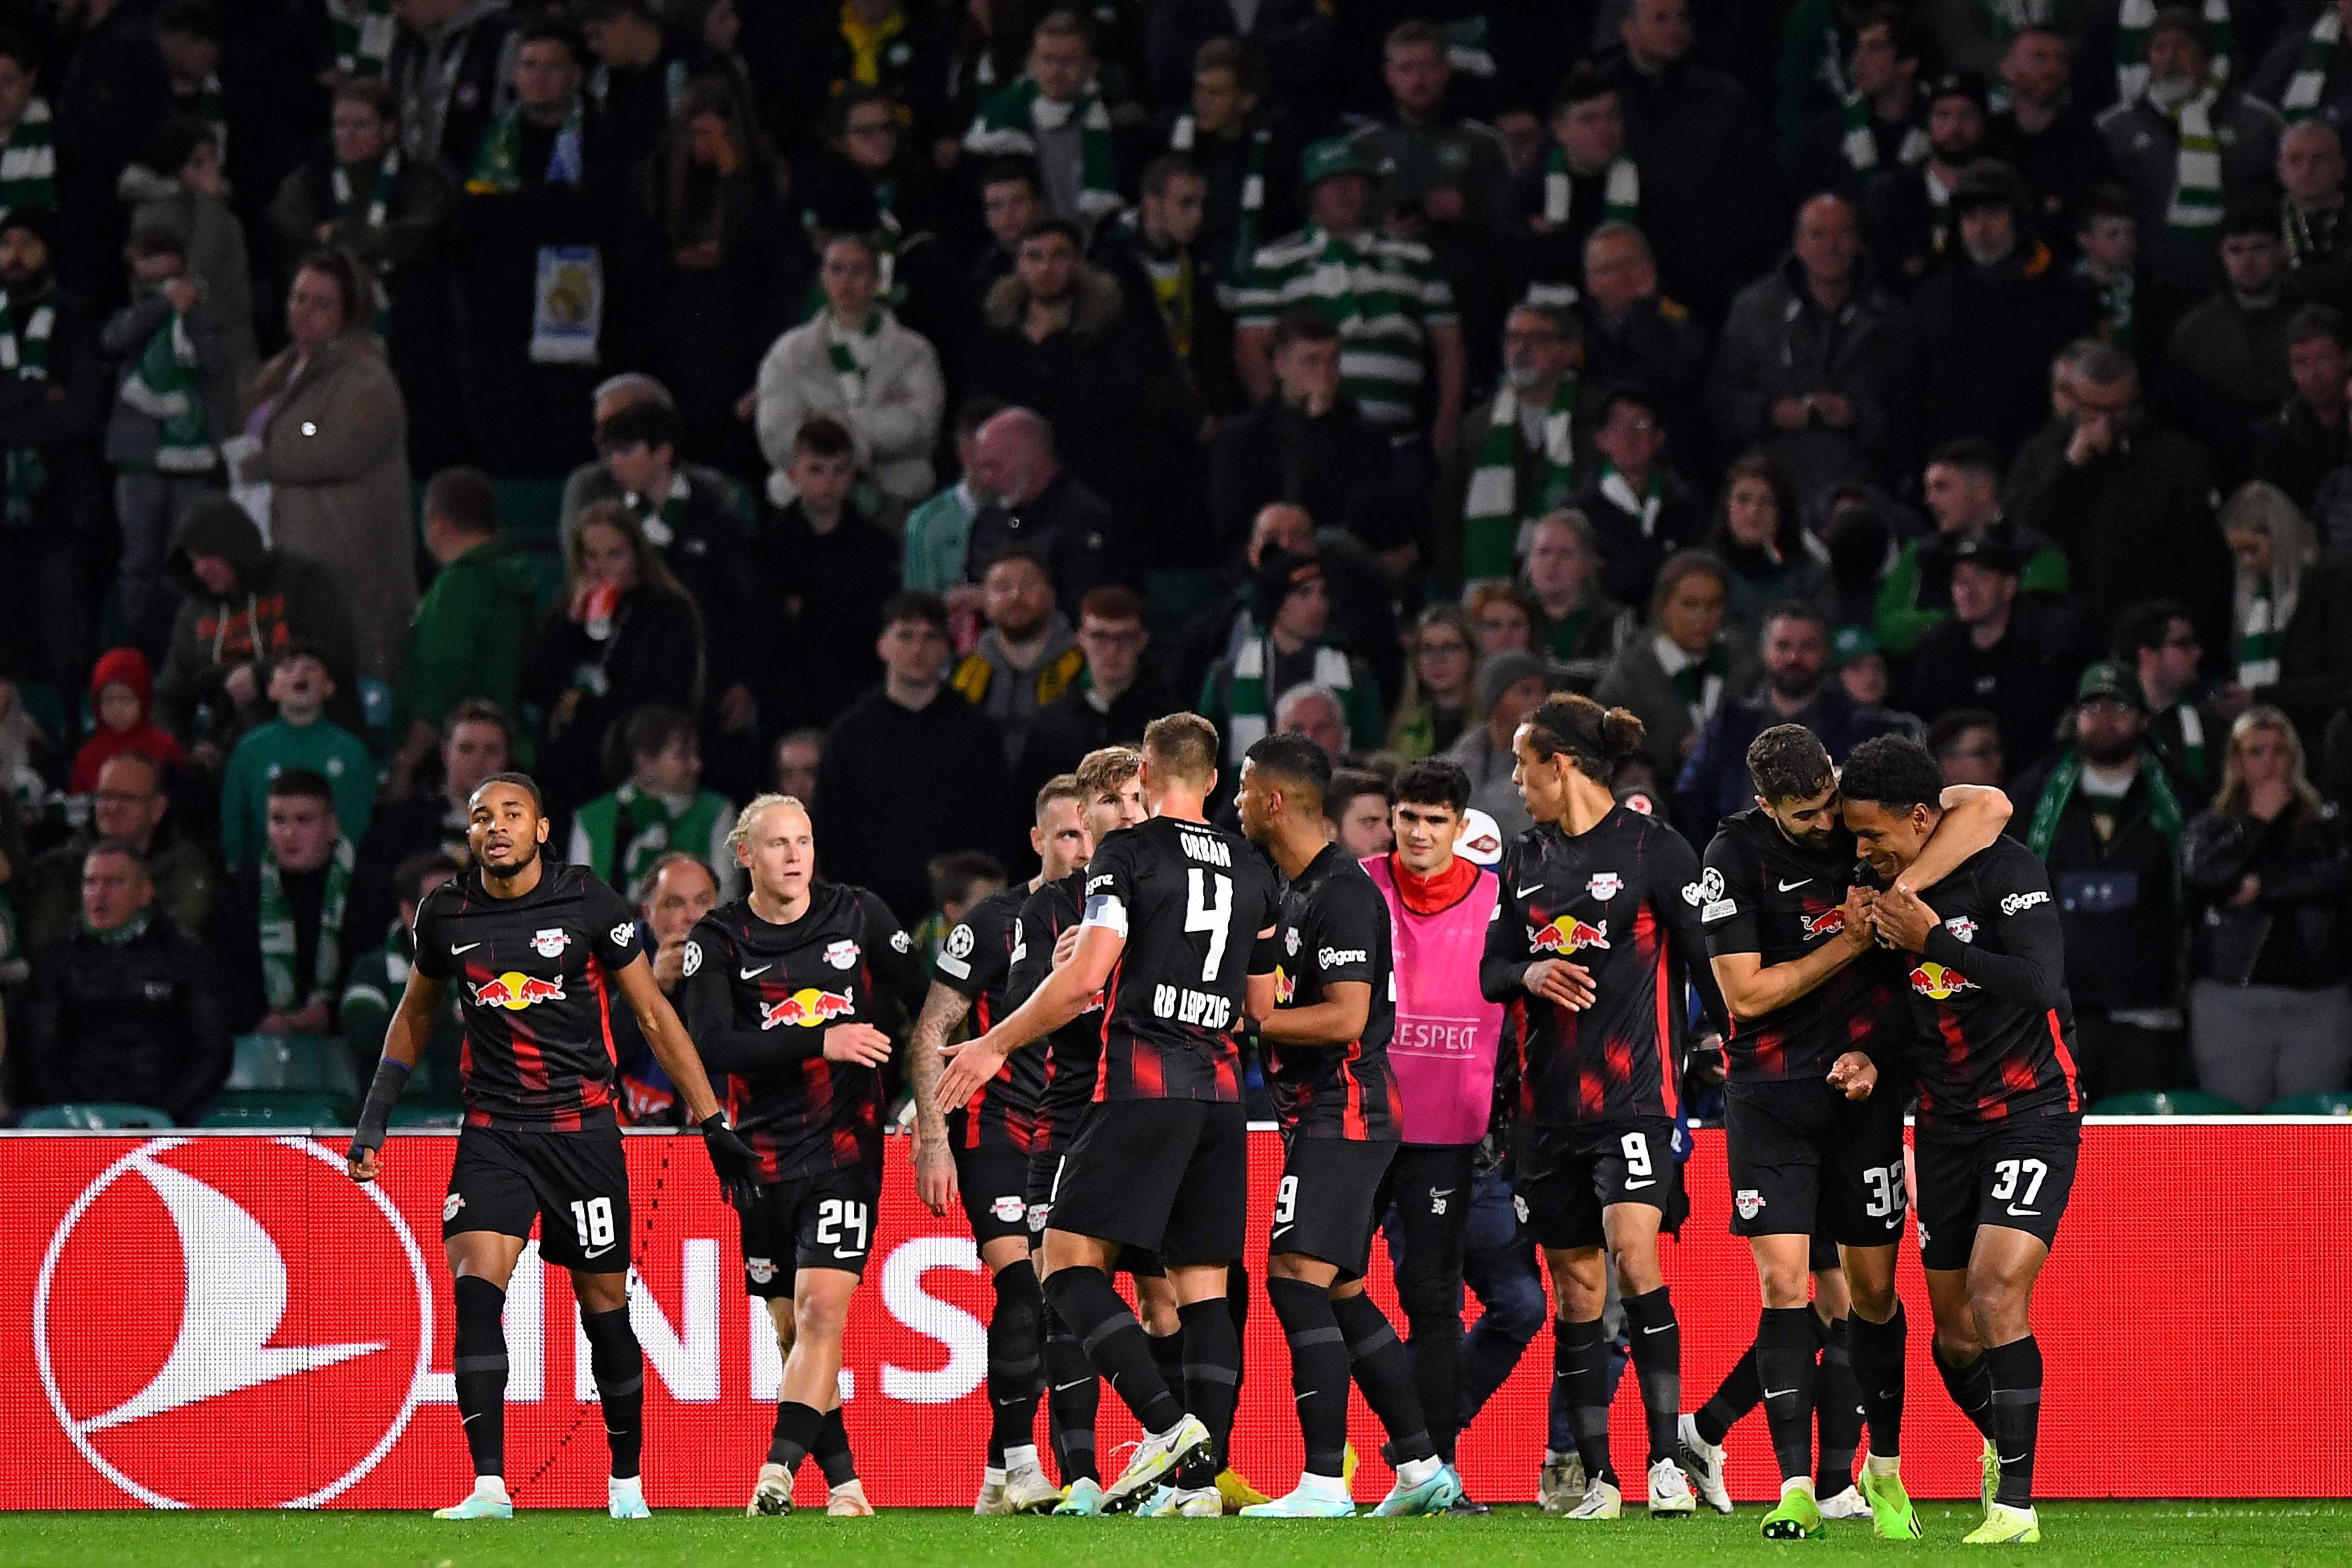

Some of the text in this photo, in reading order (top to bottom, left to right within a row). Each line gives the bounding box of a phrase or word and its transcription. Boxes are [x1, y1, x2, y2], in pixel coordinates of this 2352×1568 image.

[1184, 868, 1232, 982] 4
[1154, 984, 1231, 1029] RB LEIPZIG
[1391, 1023, 1478, 1050] ESPECT
[1621, 1132, 1652, 1176] 9
[1863, 1159, 1906, 1217] 32
[1992, 1159, 2047, 1205] 37
[570, 1197, 614, 1246] 18
[817, 1199, 867, 1249] 24
